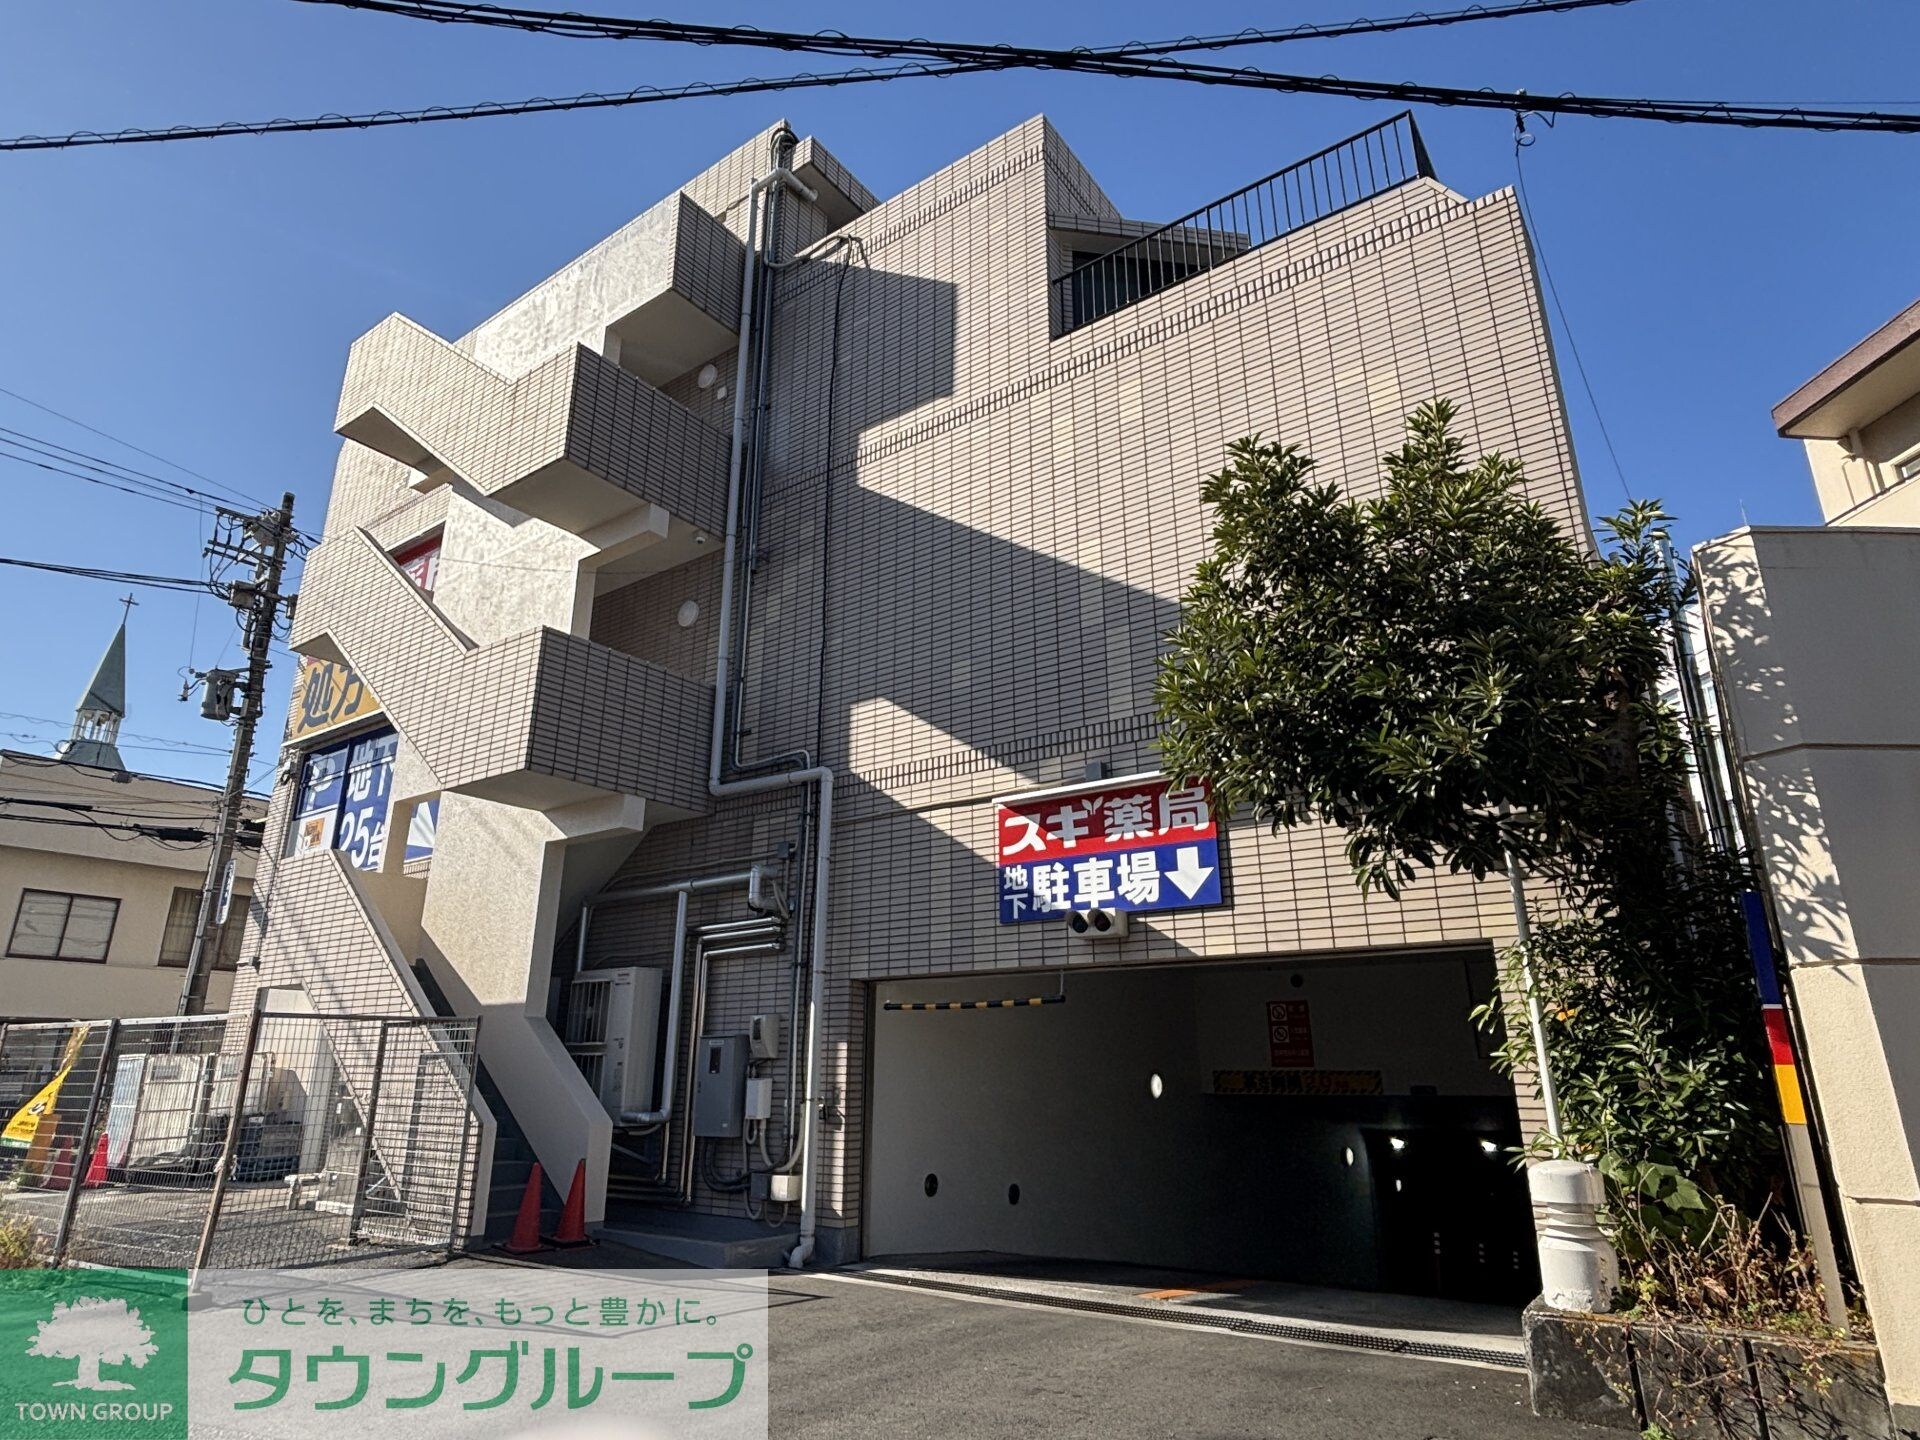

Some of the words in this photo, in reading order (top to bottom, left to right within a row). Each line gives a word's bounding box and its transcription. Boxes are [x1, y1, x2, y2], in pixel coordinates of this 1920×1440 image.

[1002, 786, 1210, 857] スギ薬局
[1003, 865, 1029, 920] 地下
[1032, 850, 1160, 915] 駐車場
